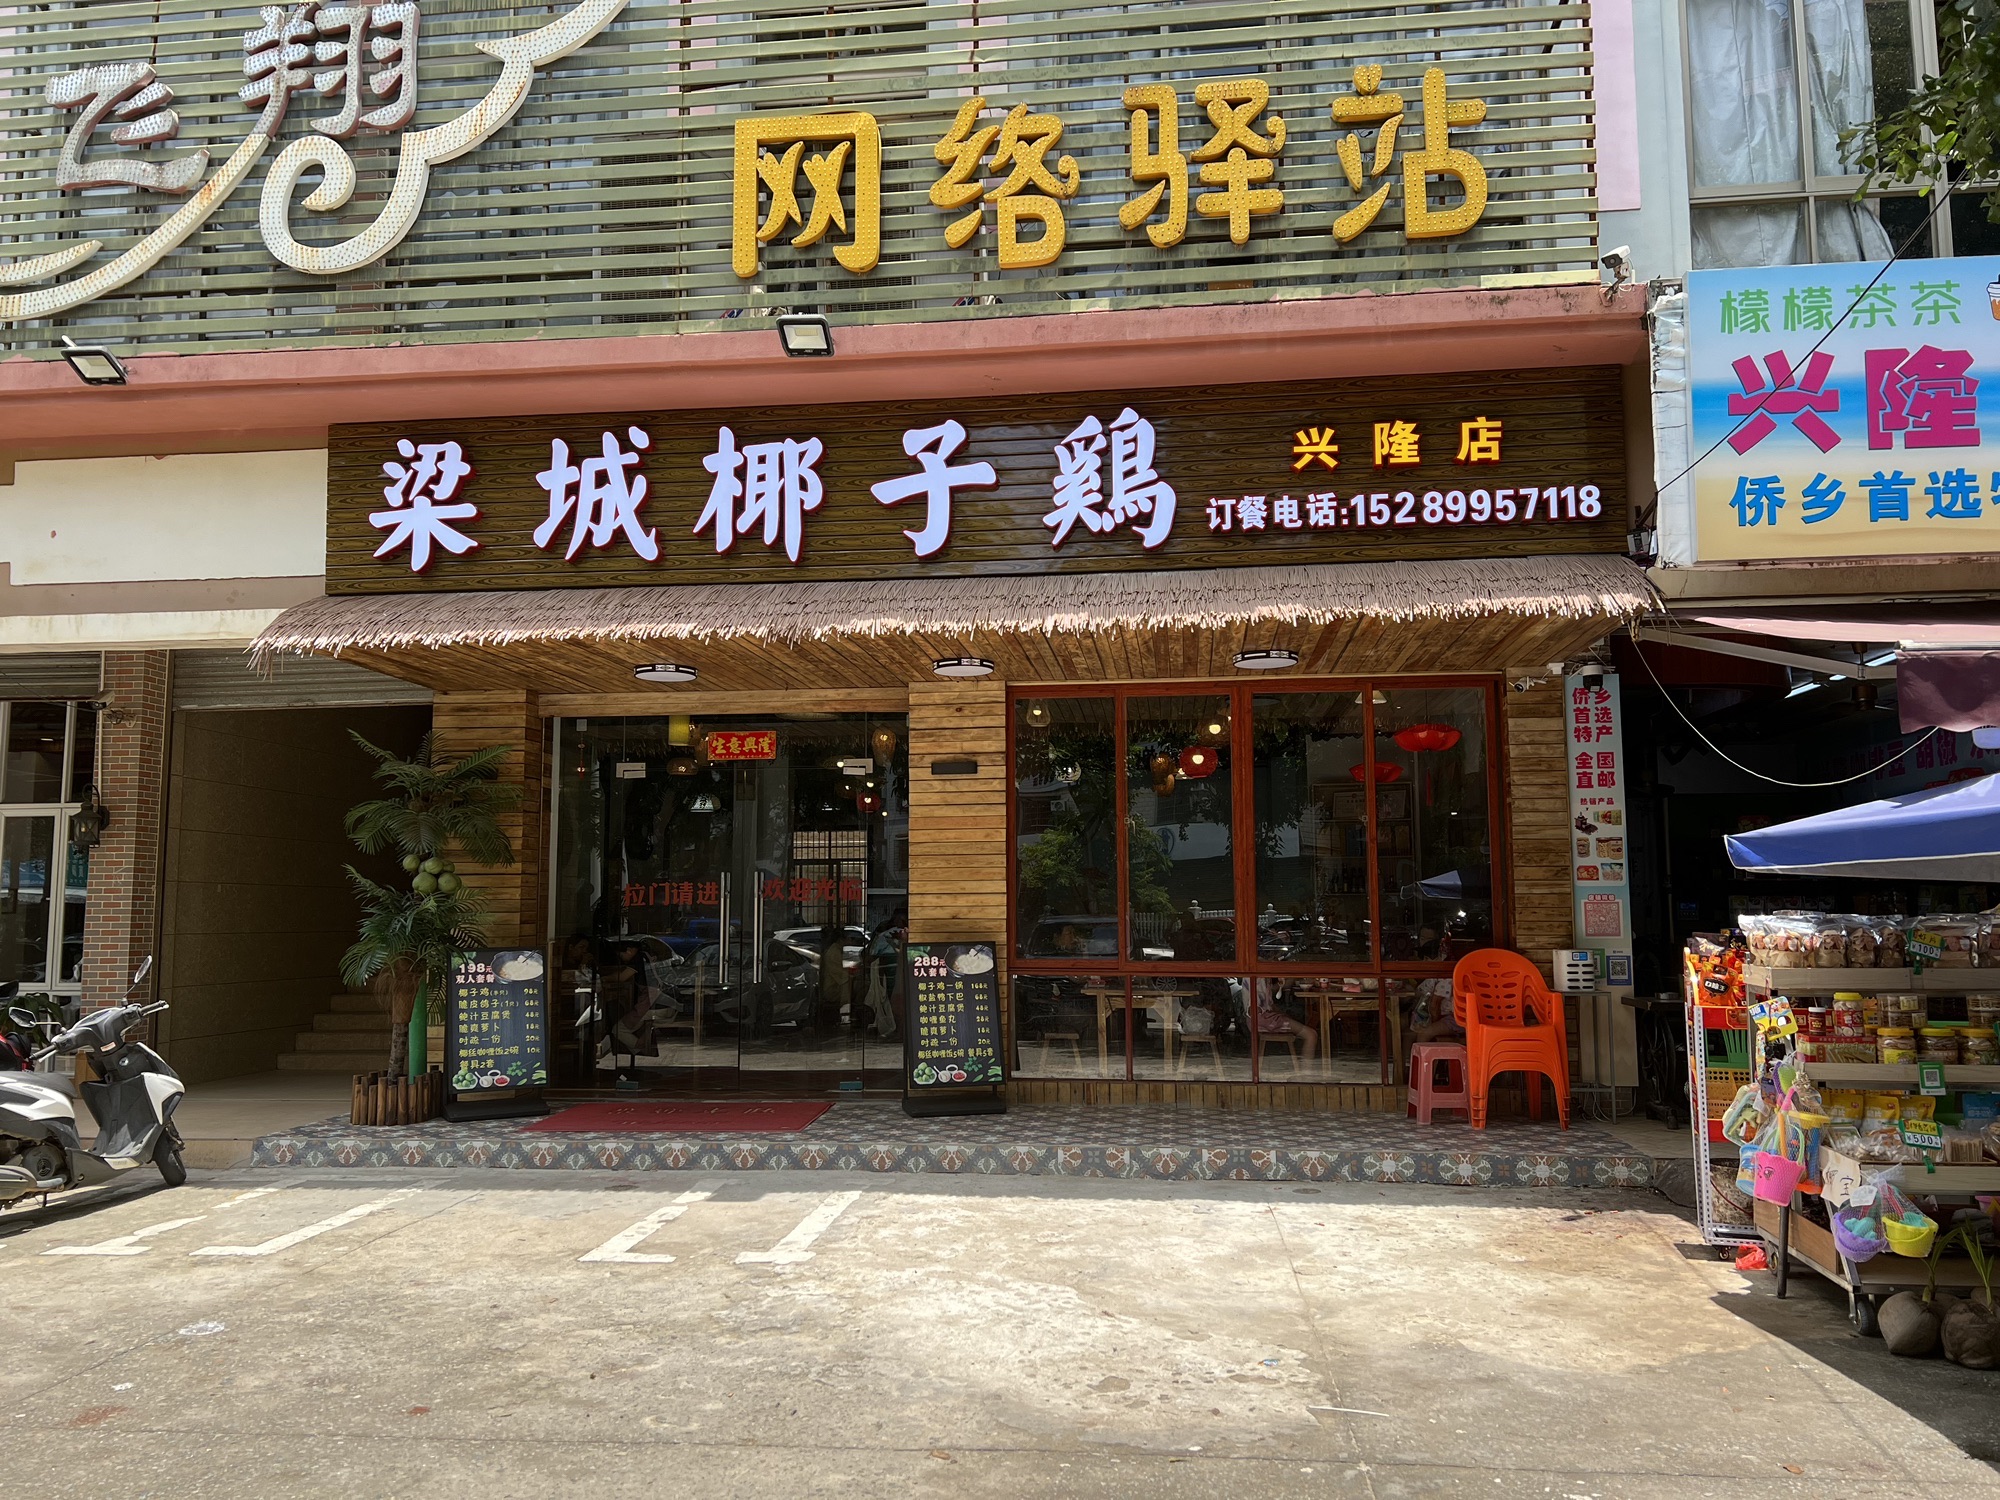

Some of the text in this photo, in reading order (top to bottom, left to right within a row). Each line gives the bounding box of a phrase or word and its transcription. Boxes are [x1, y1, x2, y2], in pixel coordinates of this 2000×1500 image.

[45, 1, 421, 195] 飞翔
[732, 64, 1488, 278] 网络驿站
[1720, 279, 1962, 335] 檬檬茶茶
[1727, 344, 1981, 456] 兴隆
[1291, 416, 1504, 470] 兴隆店
[1573, 706, 1613, 724] 首选
[1573, 725, 1613, 743] 特产
[1574, 751, 1615, 769] 全国
[1576, 771, 1616, 788] 直邮
[623, 880, 720, 908] 拉门请进
[763, 878, 863, 902] 欢迎光临
[459, 963, 492, 974] 198元
[914, 956, 946, 967] 288元
[455, 974, 495, 984] 双人套餐
[914, 968, 947, 977] 5人套餐
